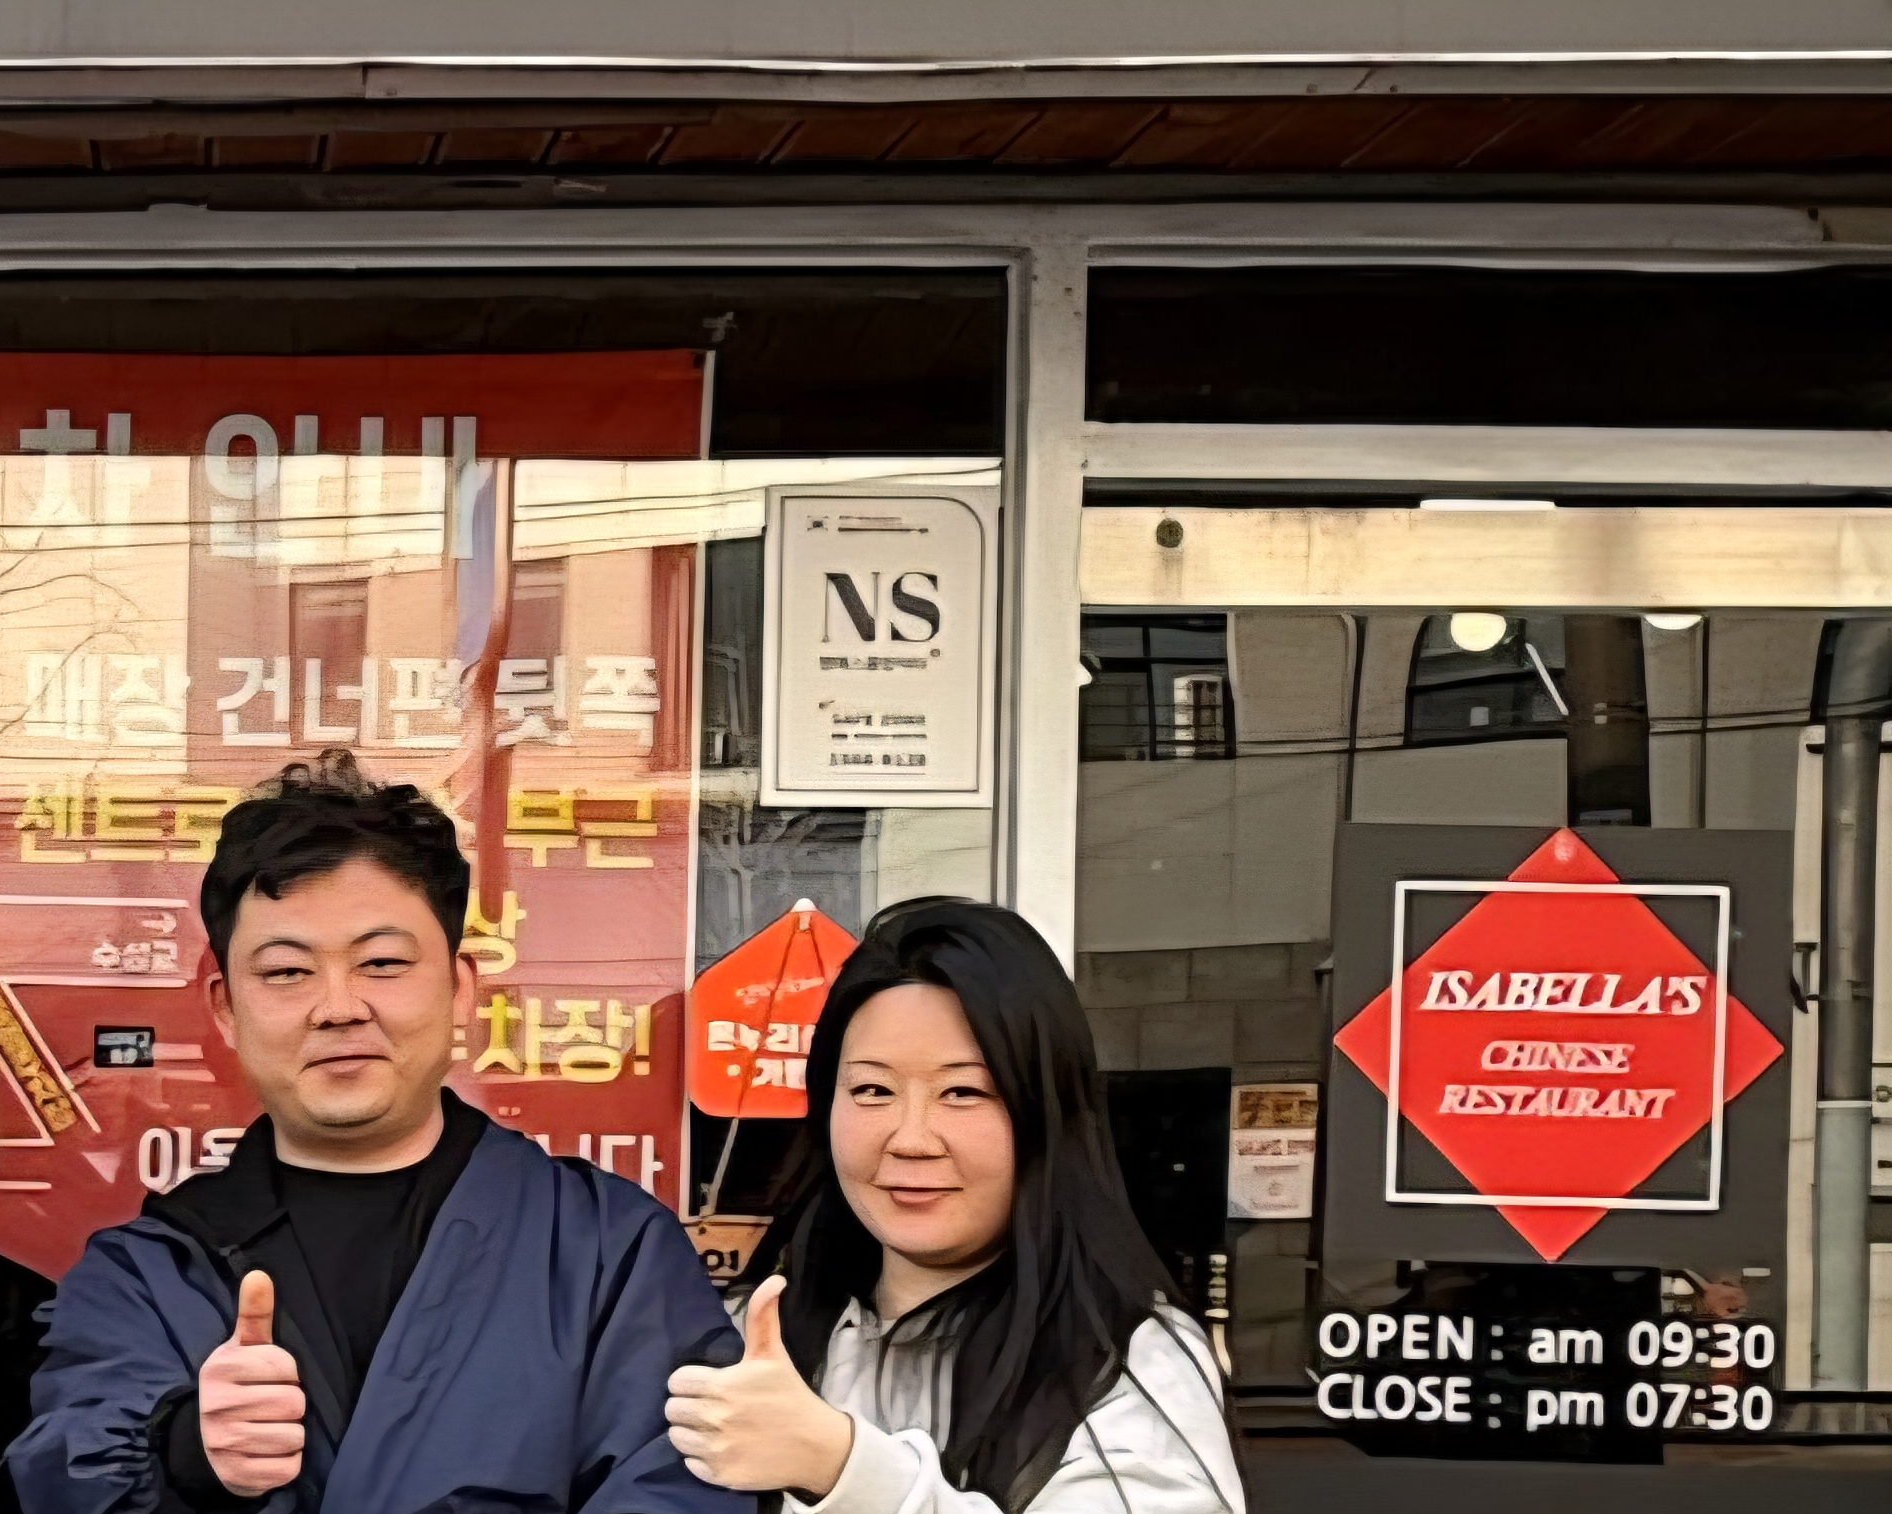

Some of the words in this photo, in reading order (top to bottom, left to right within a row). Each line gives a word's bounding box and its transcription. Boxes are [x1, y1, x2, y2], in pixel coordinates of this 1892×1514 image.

[205, 413, 479, 560] 안내
[821, 571, 941, 643] NS
[24, 653, 190, 748] 매장
[216, 656, 464, 748] 건너편
[494, 654, 660, 748] 뒷쪽
[502, 782, 658, 868] 부근
[1419, 969, 1708, 1016] ISABELLA'S
[450, 993, 652, 1084] 차장!
[1480, 1040, 1636, 1074] CHINESE
[1437, 1084, 1677, 1119] RESTAURANT
[1319, 1312, 1475, 1361] OPEN
[1527, 1328, 1604, 1364] am
[1628, 1320, 1776, 1369] 09:30
[1317, 1373, 1472, 1422] CLOSE
[1526, 1390, 1604, 1433] pm
[1626, 1382, 1774, 1431] 07:30
